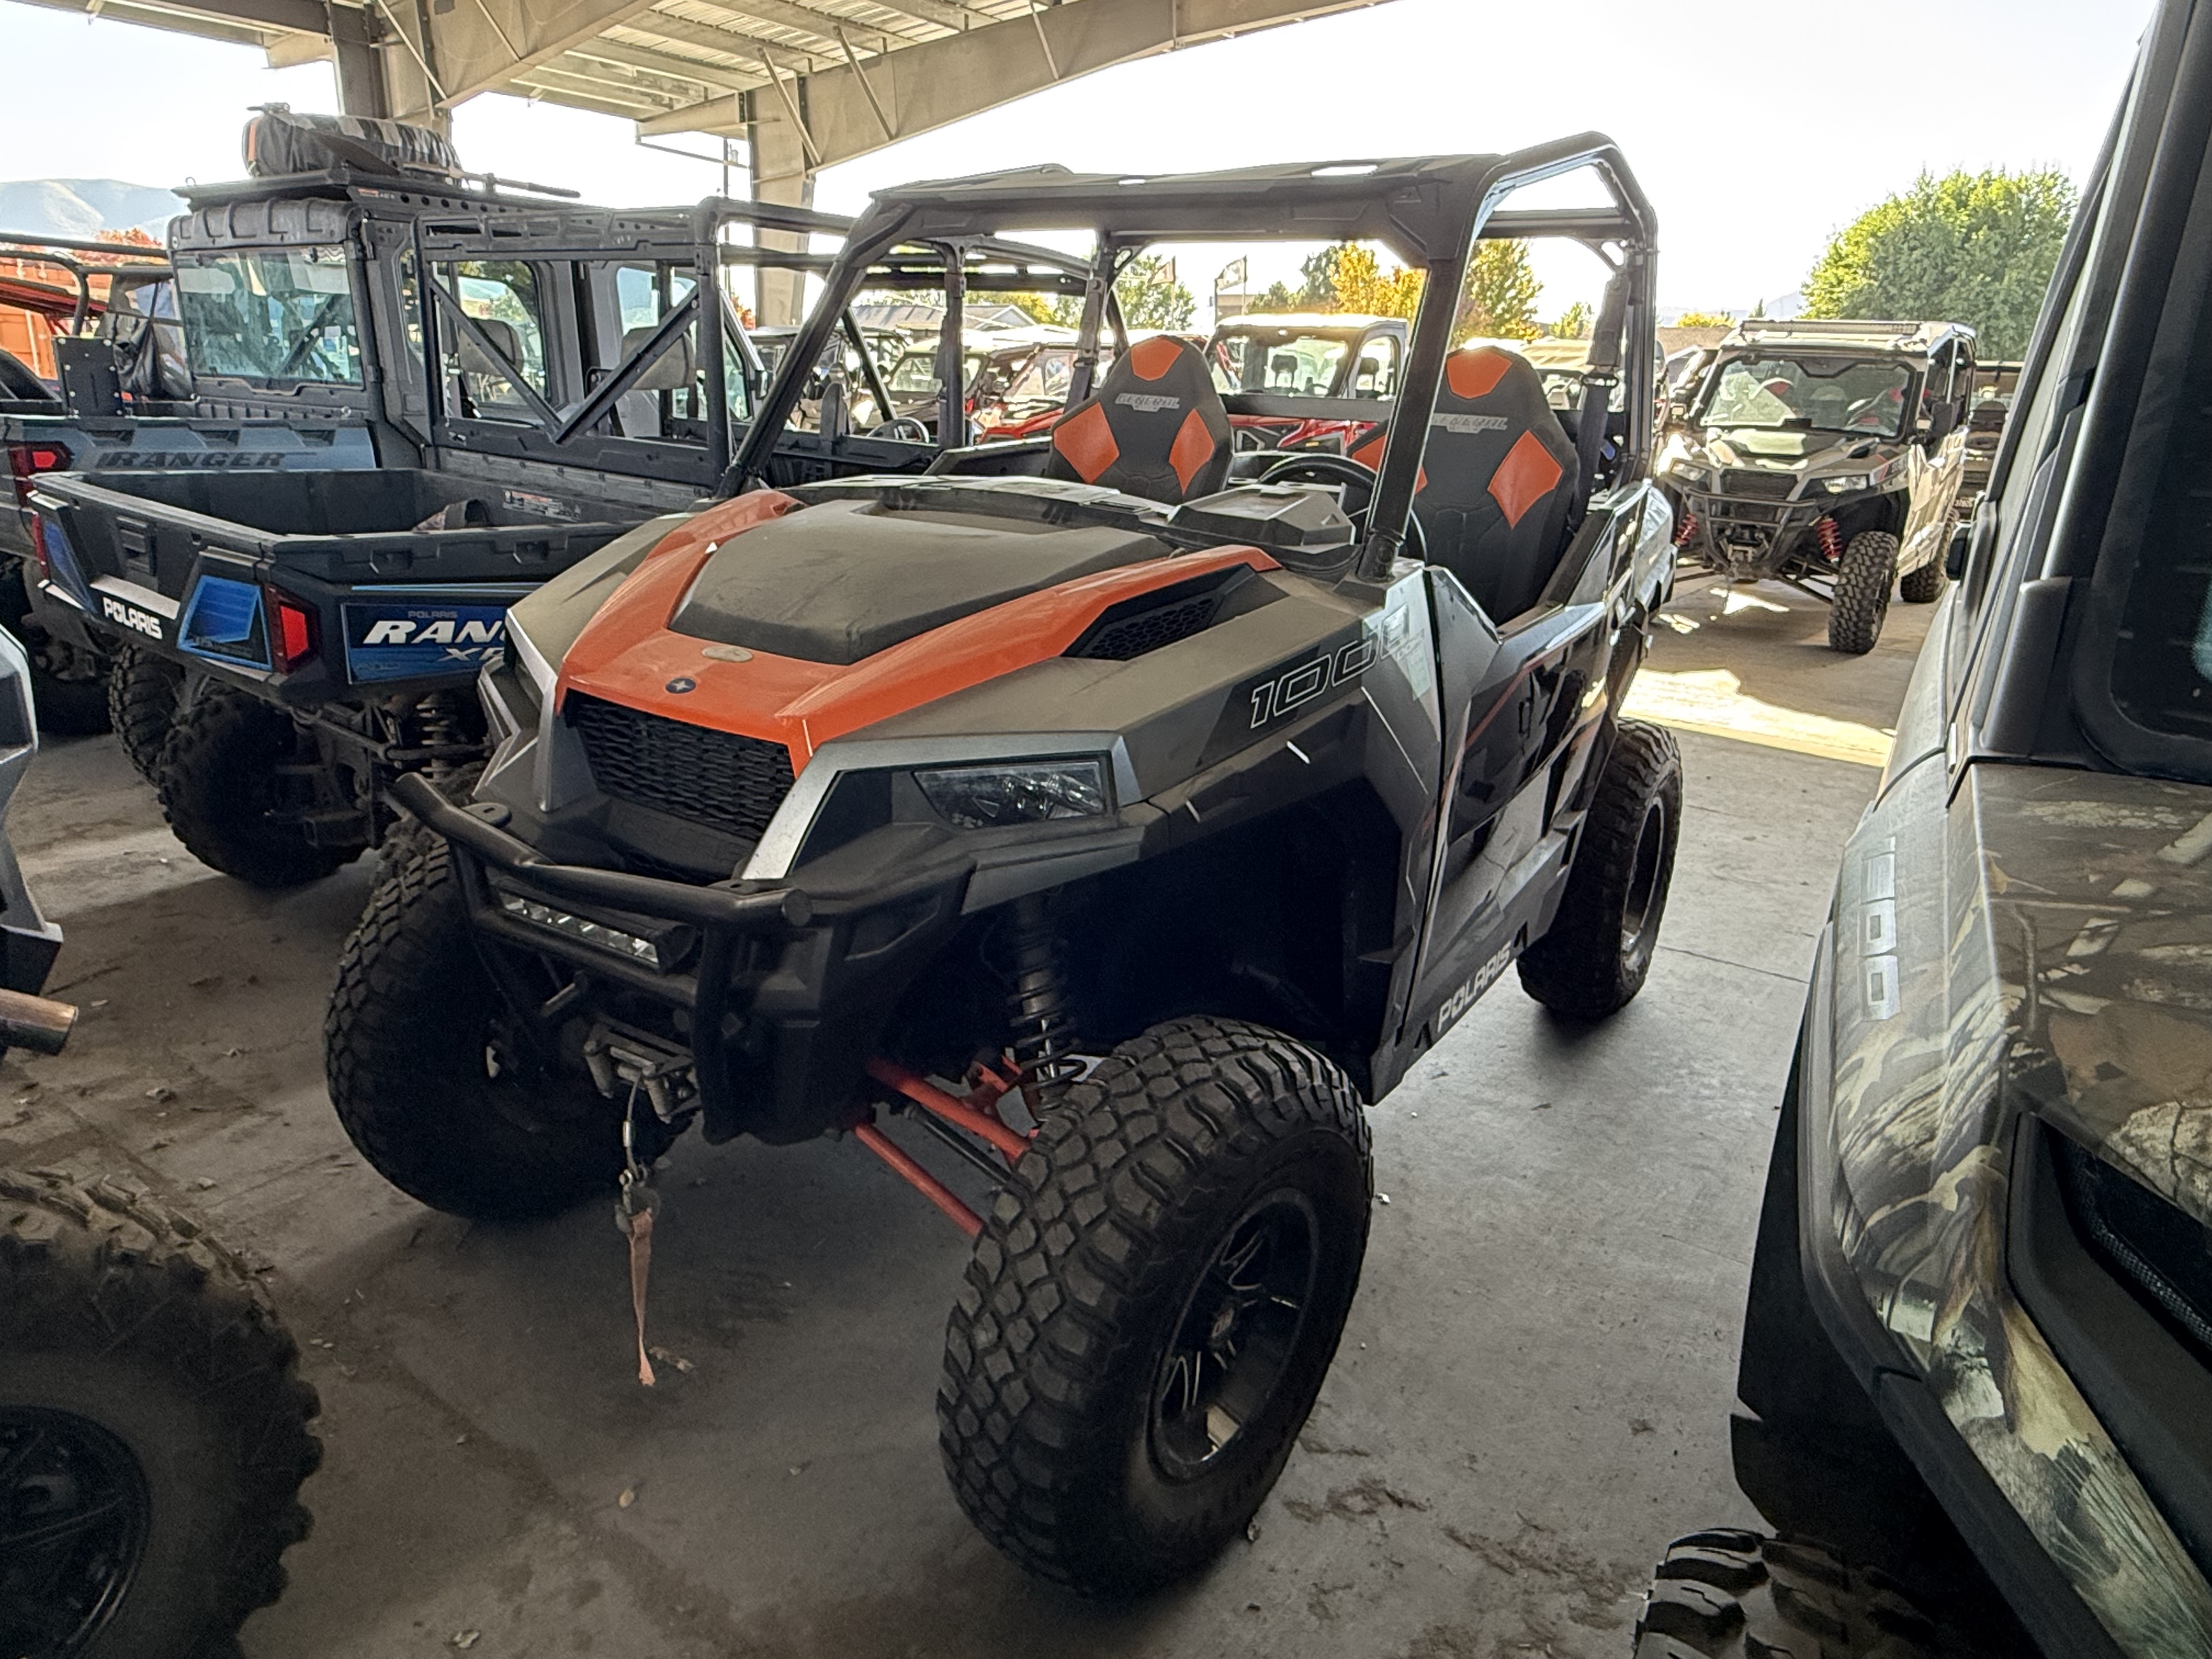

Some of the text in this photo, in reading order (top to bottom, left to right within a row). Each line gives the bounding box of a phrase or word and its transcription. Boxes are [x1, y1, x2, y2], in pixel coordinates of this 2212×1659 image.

[1115, 394, 1180, 410] GENERAL
[95, 452, 286, 467] RANGER
[103, 596, 163, 640] POLARIS
[362, 620, 505, 644] RAN
[1250, 603, 1409, 730] 1000
[1437, 939, 1511, 1032] POLARIS
